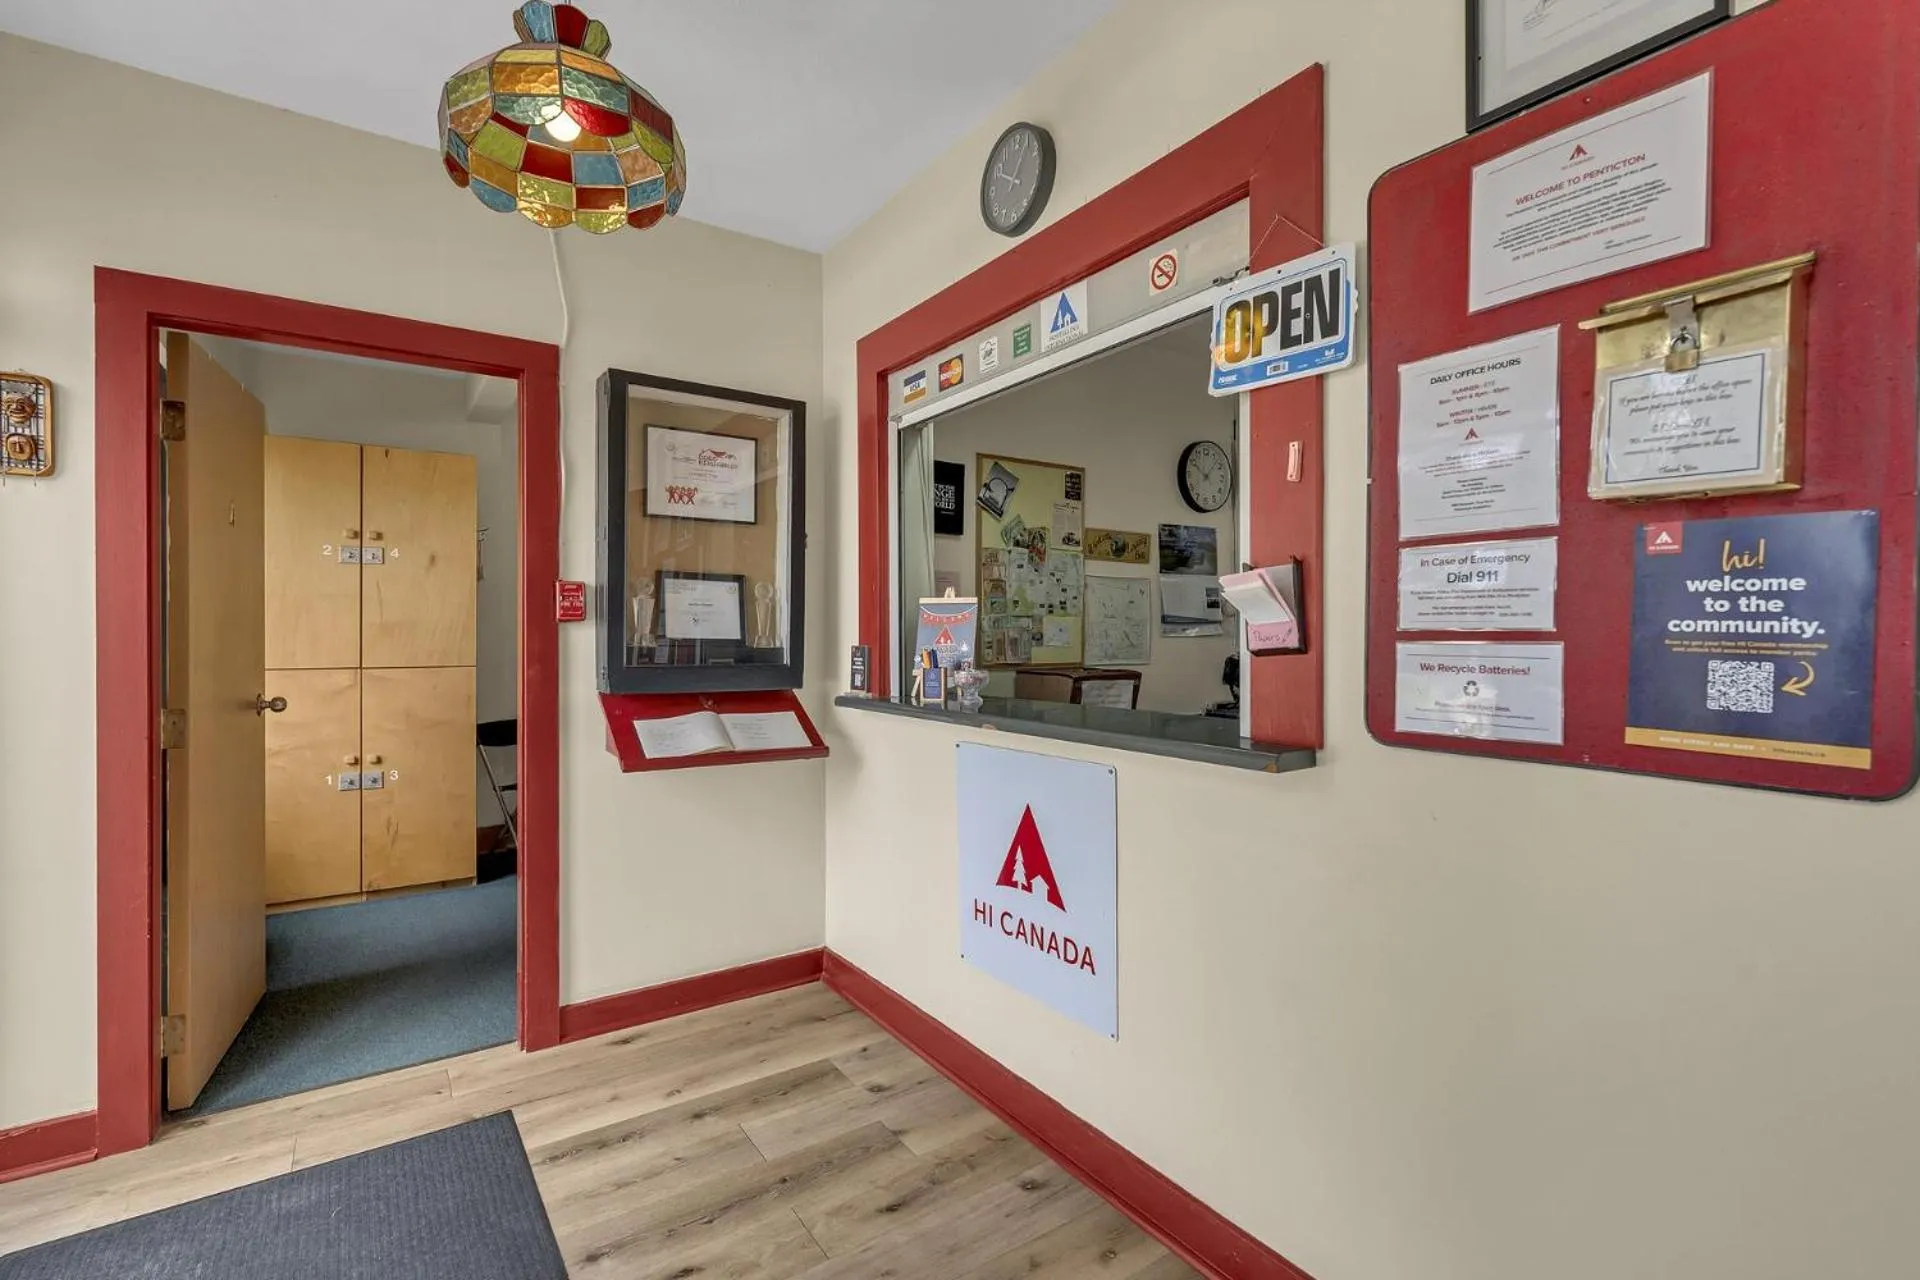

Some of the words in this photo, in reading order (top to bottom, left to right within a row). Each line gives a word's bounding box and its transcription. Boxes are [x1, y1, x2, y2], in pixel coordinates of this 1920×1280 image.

[1515, 180, 1565, 206] WELCOME
[1567, 175, 1582, 187] TO
[1583, 153, 1646, 181] PENTICTON
[1224, 268, 1341, 364] OPEN
[1430, 373, 1453, 385] DAILY
[1454, 366, 1486, 379] OFFICE
[1487, 358, 1522, 374] HOURS
[322, 544, 333, 555] 2
[389, 547, 401, 558] 4
[1722, 538, 1766, 572] hi!
[1420, 557, 1430, 567] In
[1431, 557, 1457, 567] Case
[1457, 555, 1468, 565] of
[1470, 553, 1531, 566] Emergency
[1447, 570, 1473, 584] Dial
[1475, 570, 1499, 583] 911
[1686, 575, 1808, 592] welcome
[1703, 597, 1731, 613] to
[1738, 595, 1785, 613] the
[1667, 616, 1826, 638] community.
[1420, 662, 1436, 672] We
[1437, 663, 1477, 674] Recycle
[1478, 664, 1532, 676] Batteries!
[325, 775, 333, 785] 1
[389, 769, 399, 781] 3
[974, 898, 993, 928] HI
[1000, 911, 1096, 975] CANADA
